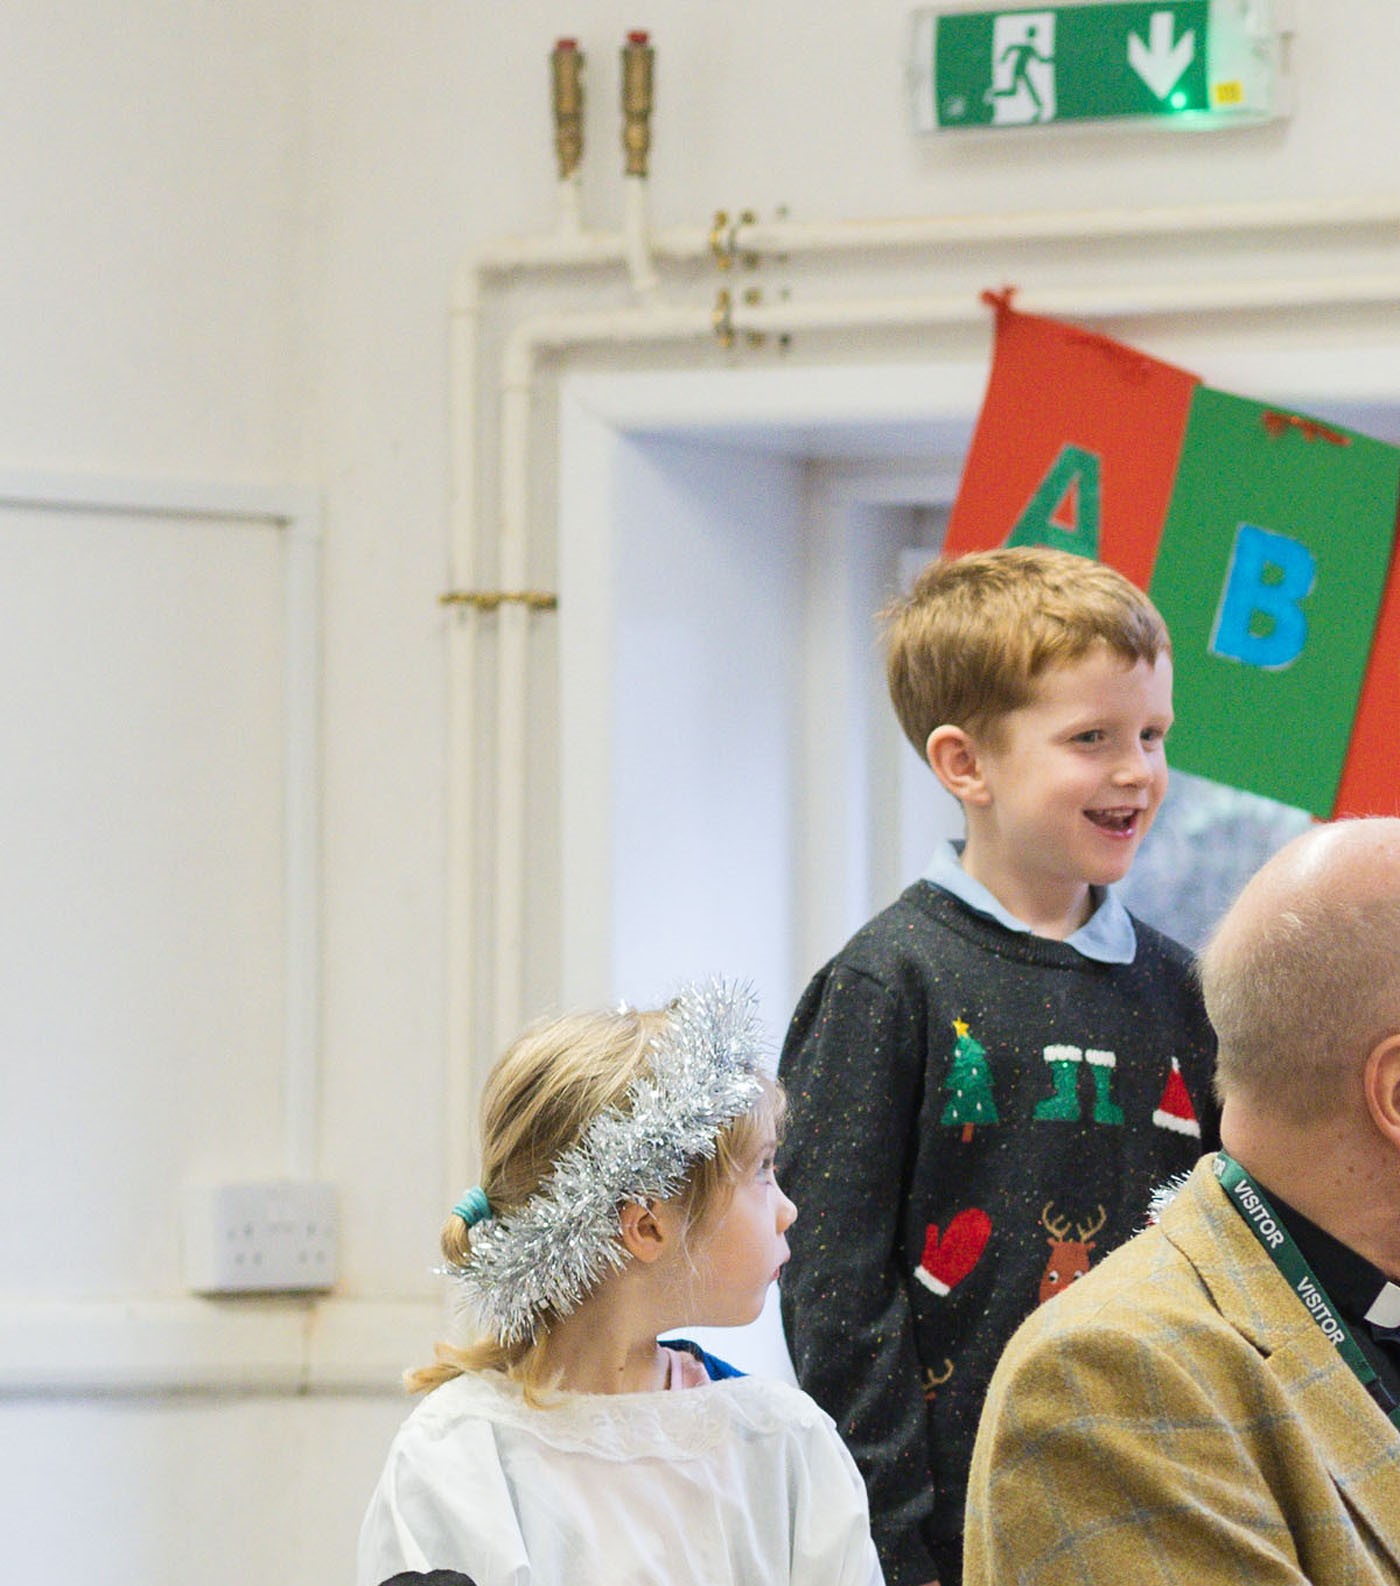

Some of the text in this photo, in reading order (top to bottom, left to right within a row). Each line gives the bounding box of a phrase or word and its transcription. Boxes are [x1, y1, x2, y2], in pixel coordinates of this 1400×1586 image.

[1002, 443, 1101, 562] A
[1208, 522, 1316, 671] B
[1234, 1179, 1285, 1249] VISITOR
[1297, 1276, 1345, 1346] VISITOR
